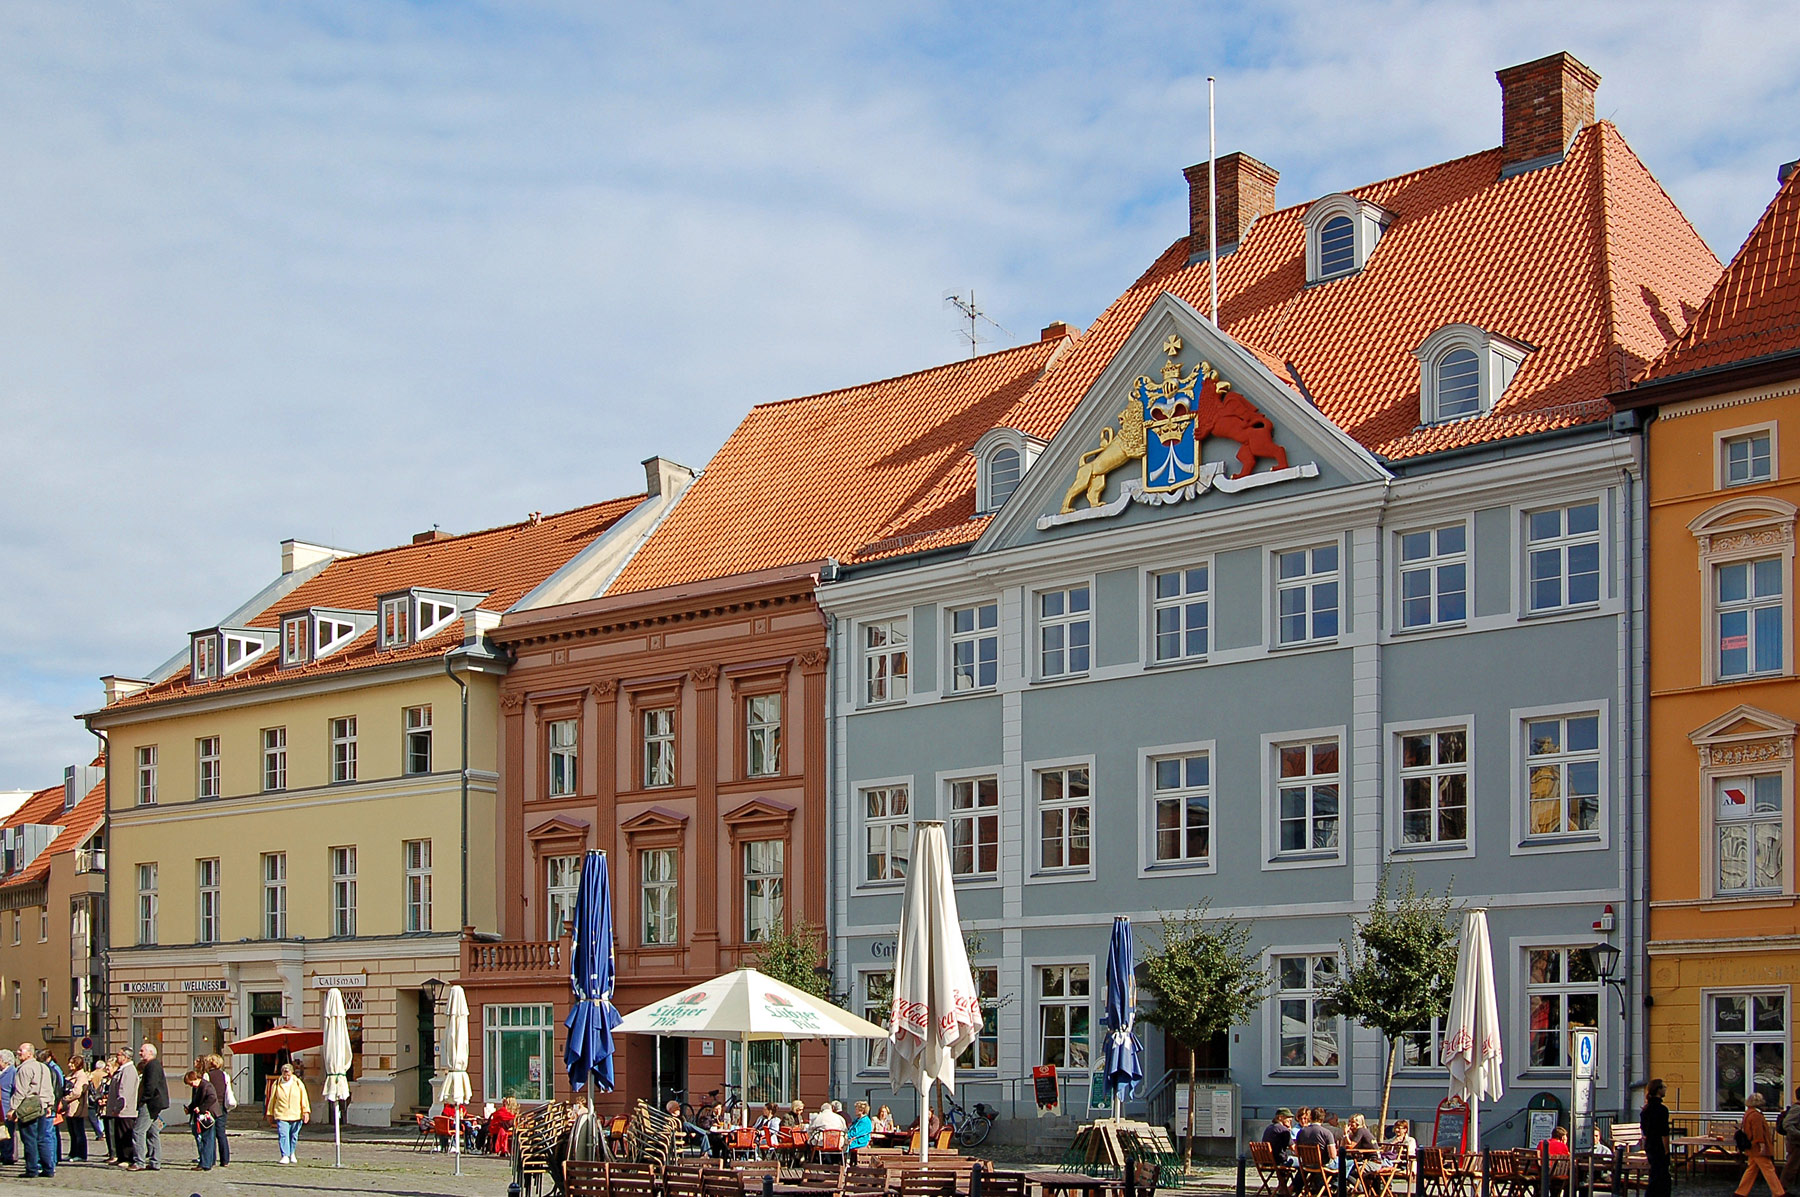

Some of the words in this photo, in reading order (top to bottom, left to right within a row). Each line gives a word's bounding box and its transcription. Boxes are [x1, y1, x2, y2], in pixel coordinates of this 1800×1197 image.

[871, 941, 896, 960] Caf
[131, 982, 166, 992] KOSMETIK
[184, 981, 220, 991] WELLNESS
[648, 1004, 707, 1017] Lübzer
[764, 1005, 820, 1020] Lübzer
[650, 1016, 678, 1027] Pils
[790, 1018, 821, 1030] Pils
